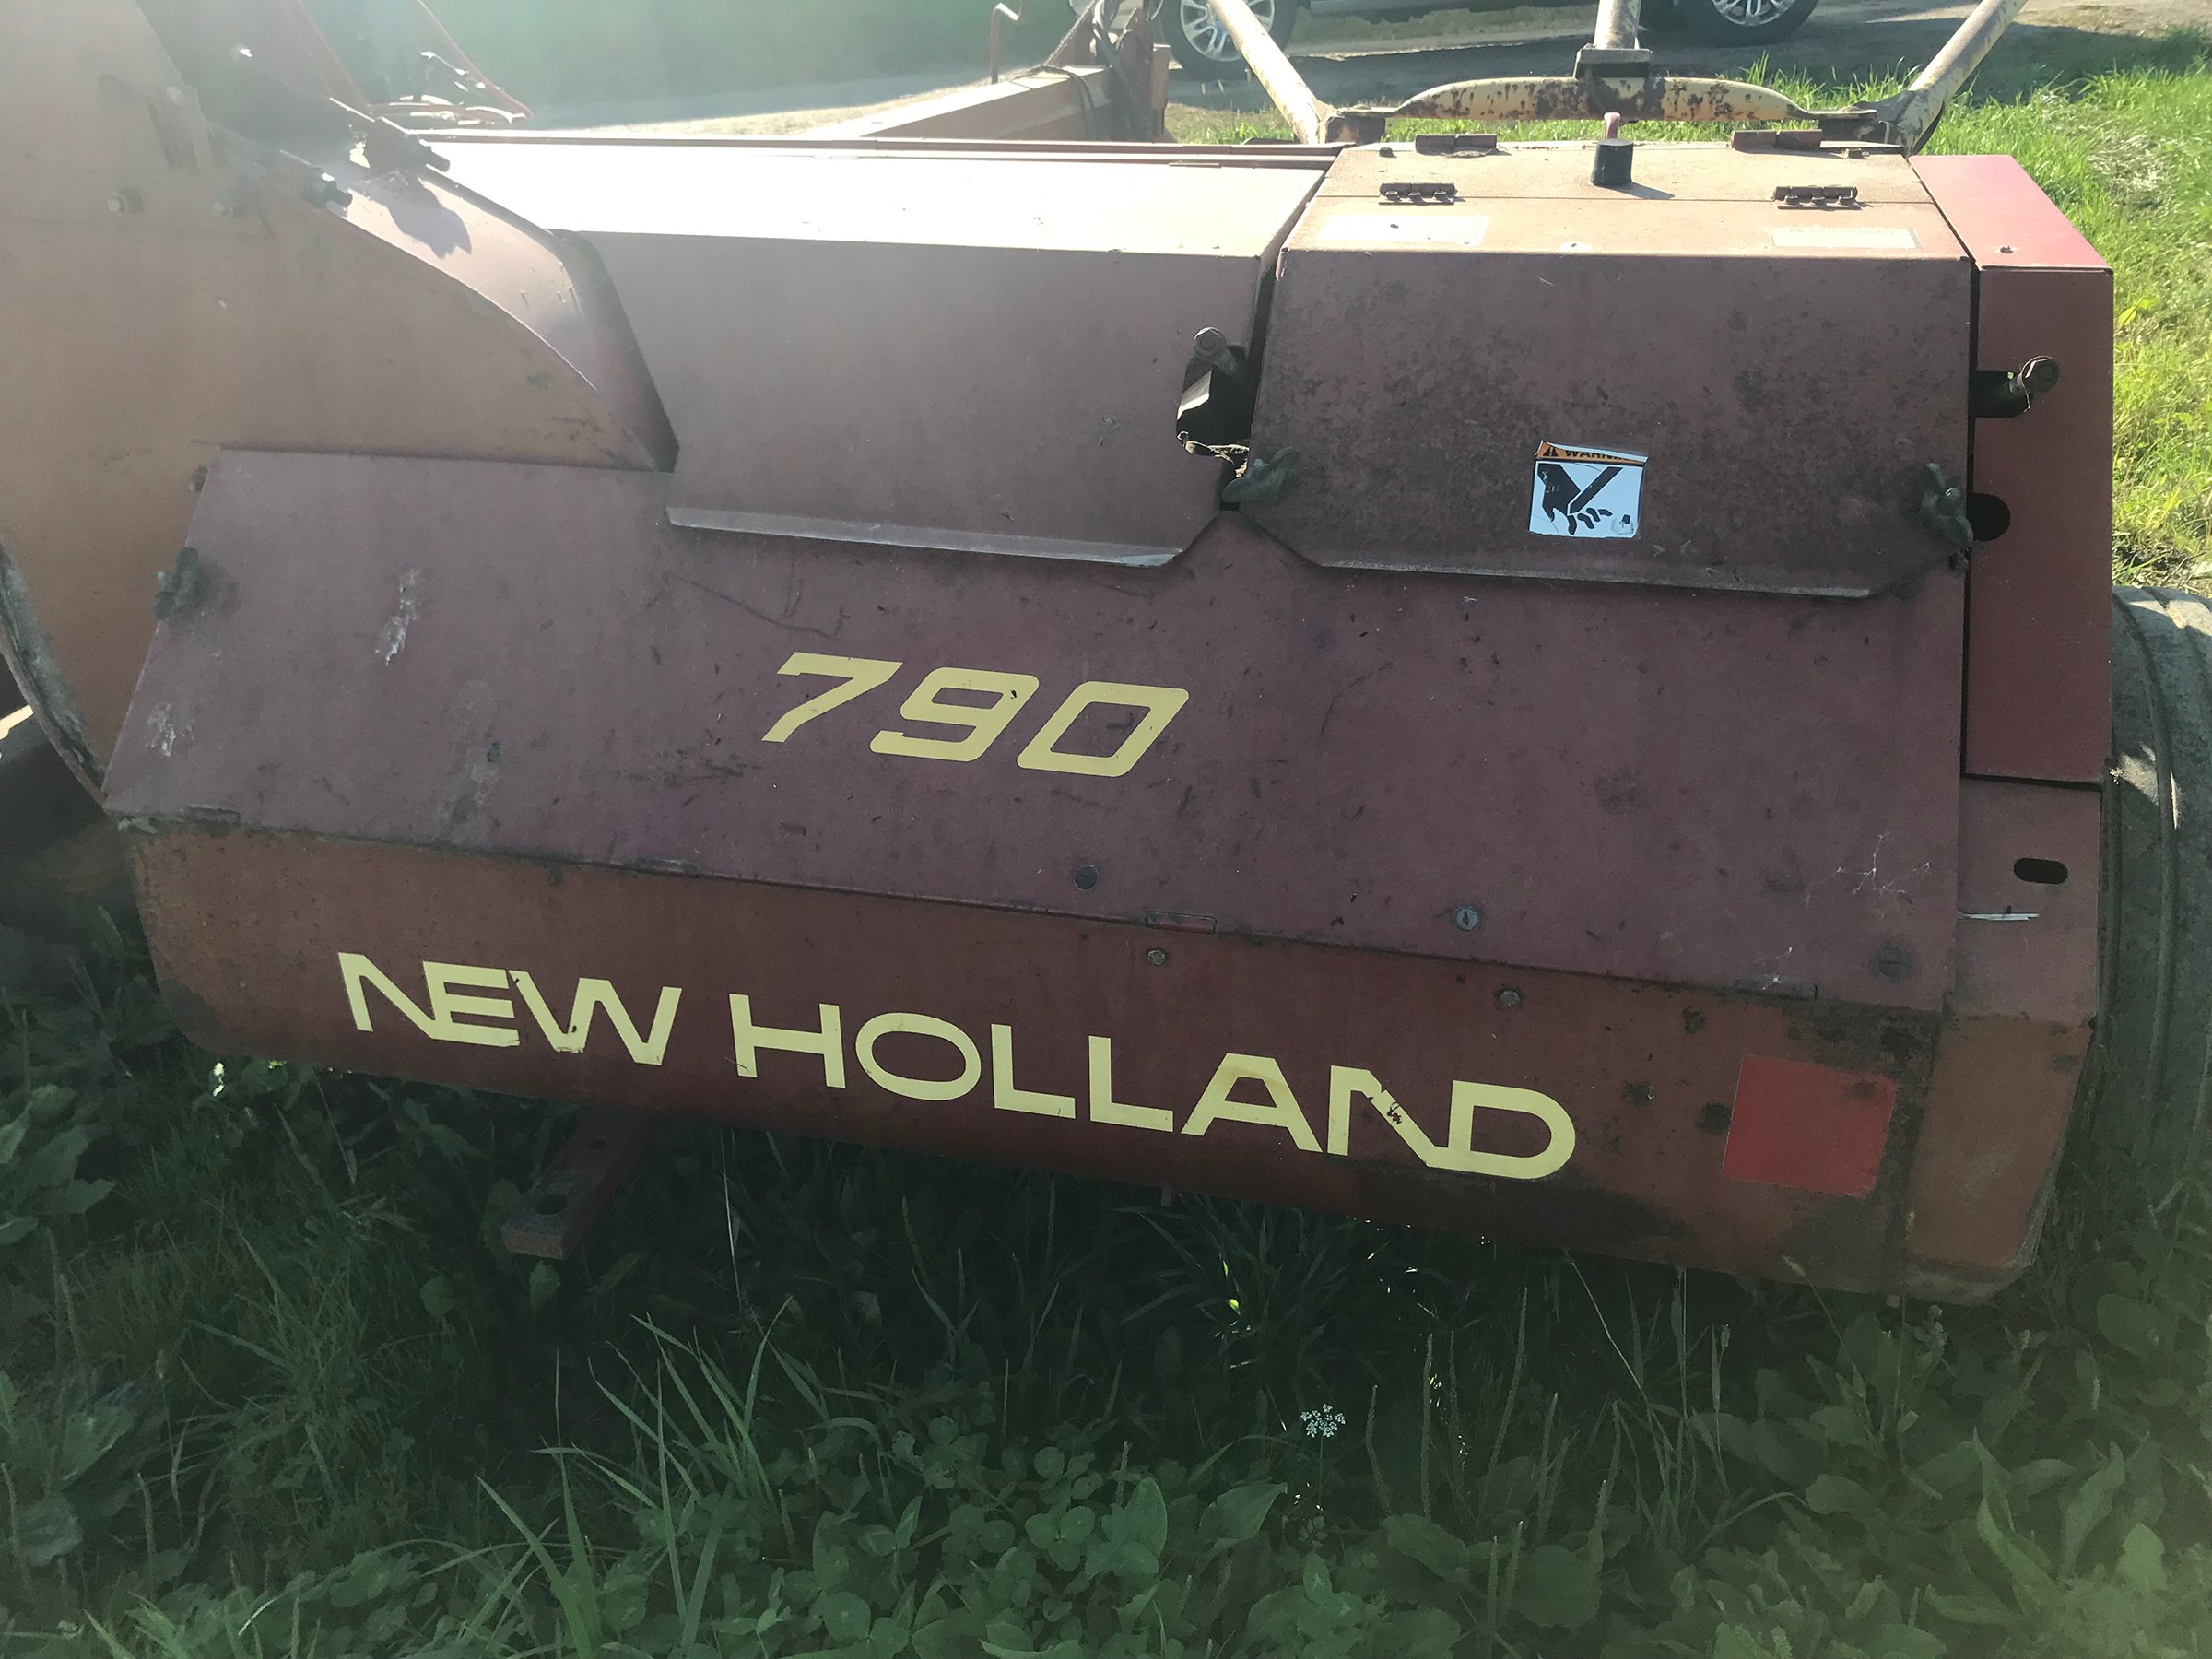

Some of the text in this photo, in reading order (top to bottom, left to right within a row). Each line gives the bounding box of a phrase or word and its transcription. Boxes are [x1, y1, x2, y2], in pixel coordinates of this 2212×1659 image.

[761, 651, 1189, 777] 790
[338, 952, 1576, 1180] NEW HOLLAND
